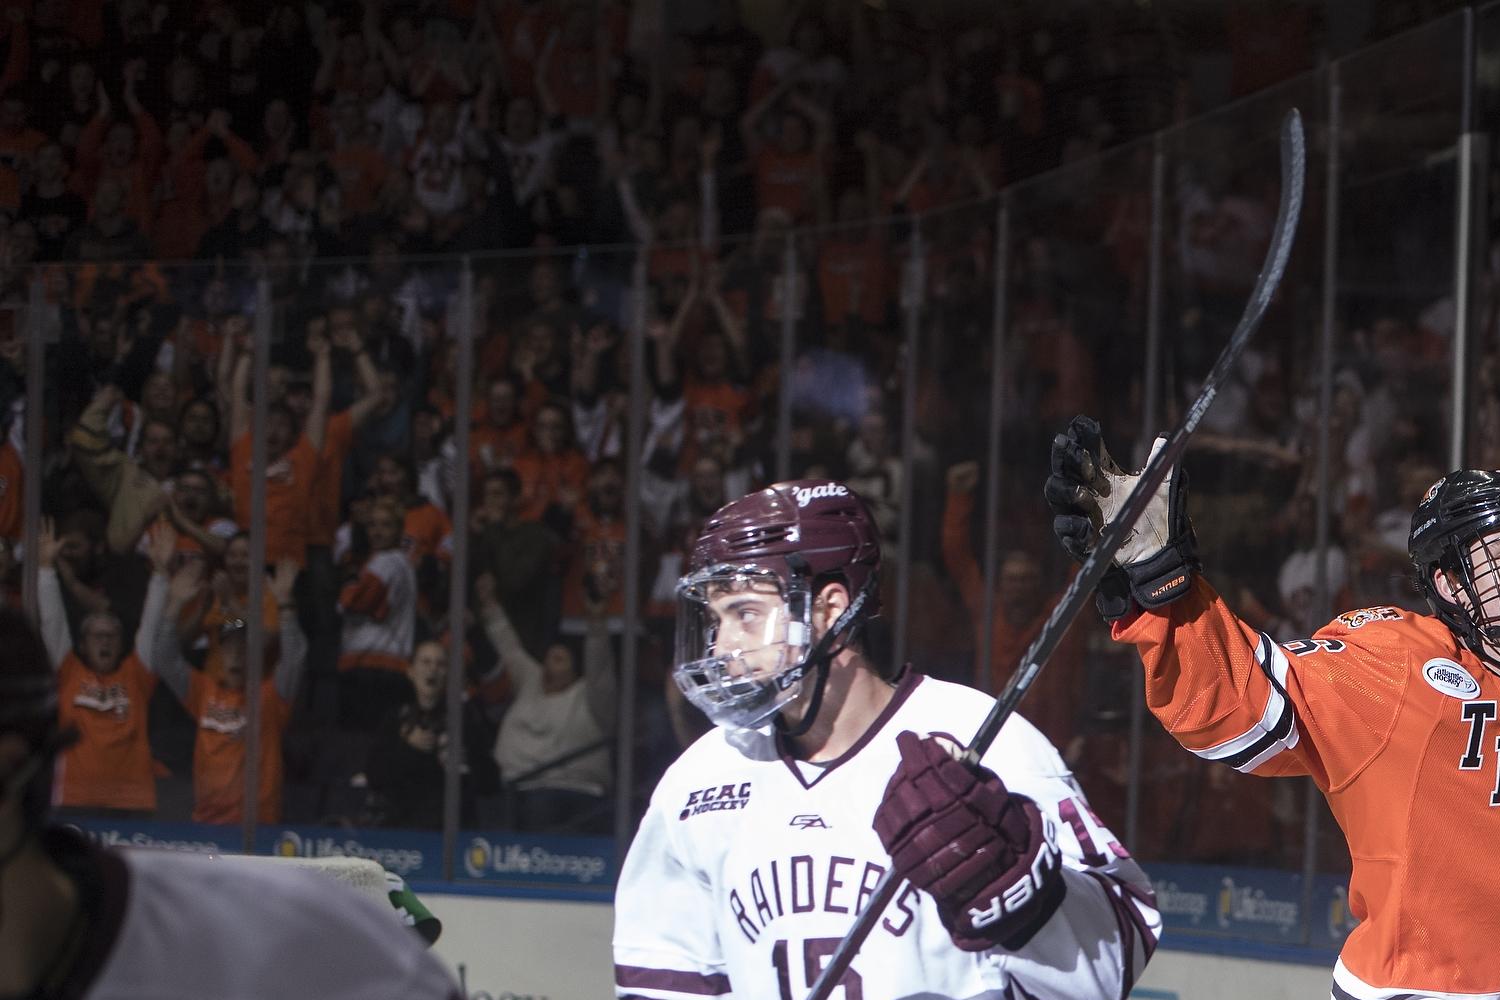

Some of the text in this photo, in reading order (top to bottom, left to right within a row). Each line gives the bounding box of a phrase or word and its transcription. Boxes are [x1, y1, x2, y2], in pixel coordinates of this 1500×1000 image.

[791, 482, 849, 508] 'gate
[685, 782, 752, 807] ECAC
[691, 798, 750, 816] HOCKEY
[493, 843, 606, 882] LifeStorage
[729, 854, 921, 944] RAIDERS
